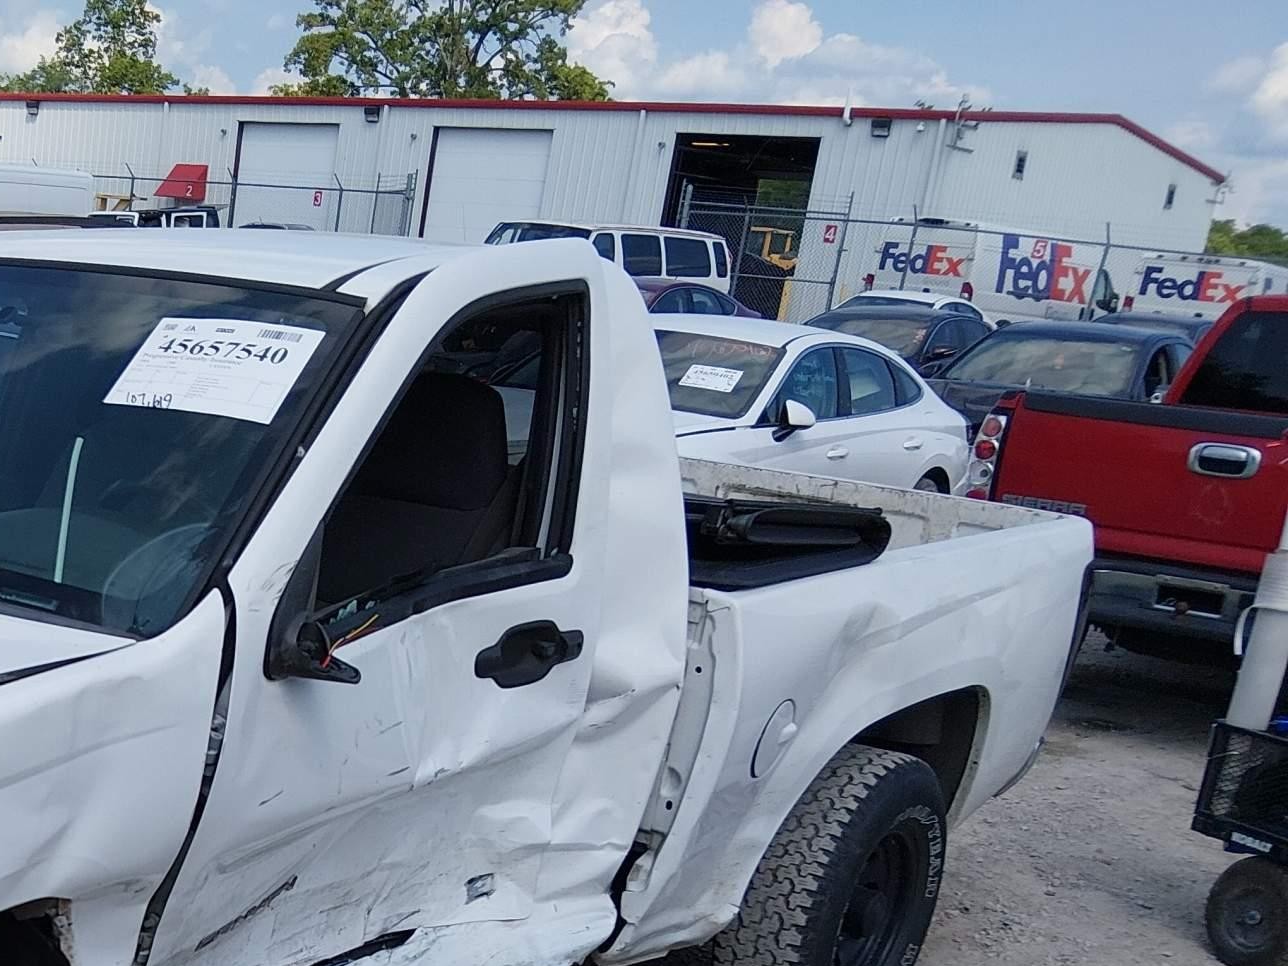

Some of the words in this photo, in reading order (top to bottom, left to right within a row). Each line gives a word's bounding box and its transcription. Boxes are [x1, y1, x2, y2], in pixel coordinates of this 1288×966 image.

[185, 185, 193, 197] 2
[824, 226, 836, 242] 4
[878, 241, 966, 277] FedEx
[1032, 240, 1047, 258] 5
[995, 233, 1092, 305] FedEx
[1139, 265, 1248, 304] FedEx
[159, 337, 289, 365] 45657540
